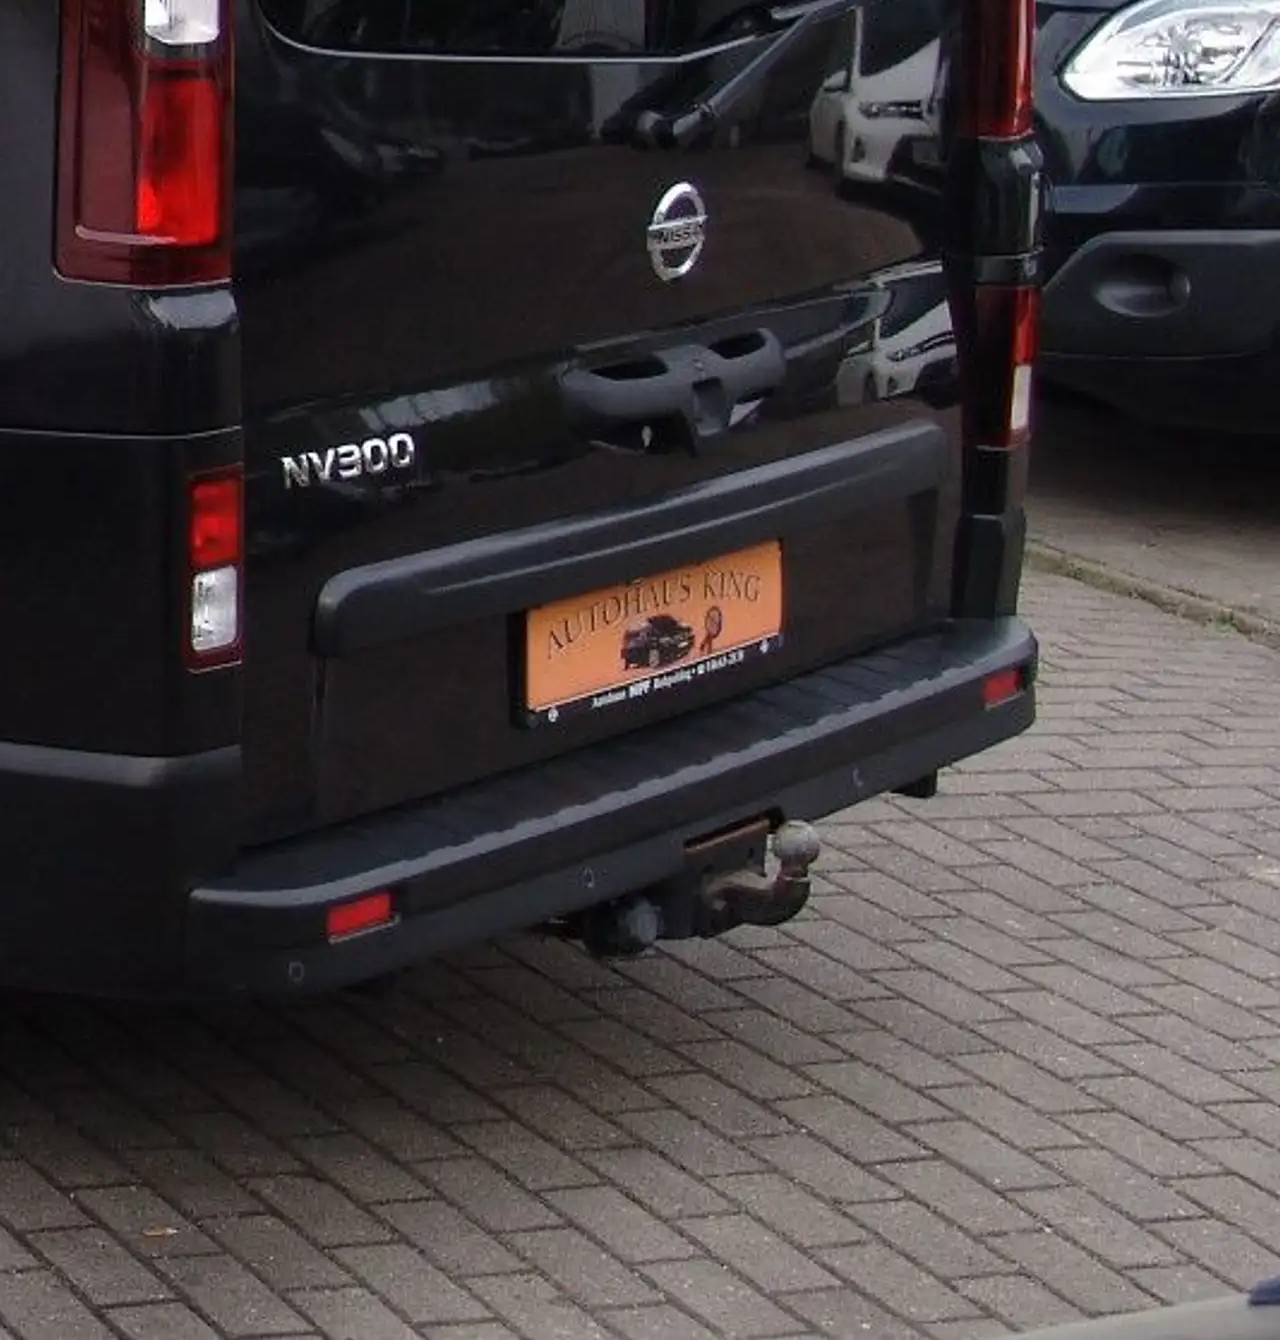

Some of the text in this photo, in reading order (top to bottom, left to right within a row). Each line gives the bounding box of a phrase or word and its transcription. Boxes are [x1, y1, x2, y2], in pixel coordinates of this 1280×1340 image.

[281, 432, 415, 489] NV300
[546, 569, 761, 660] AUTOHAUS KING
